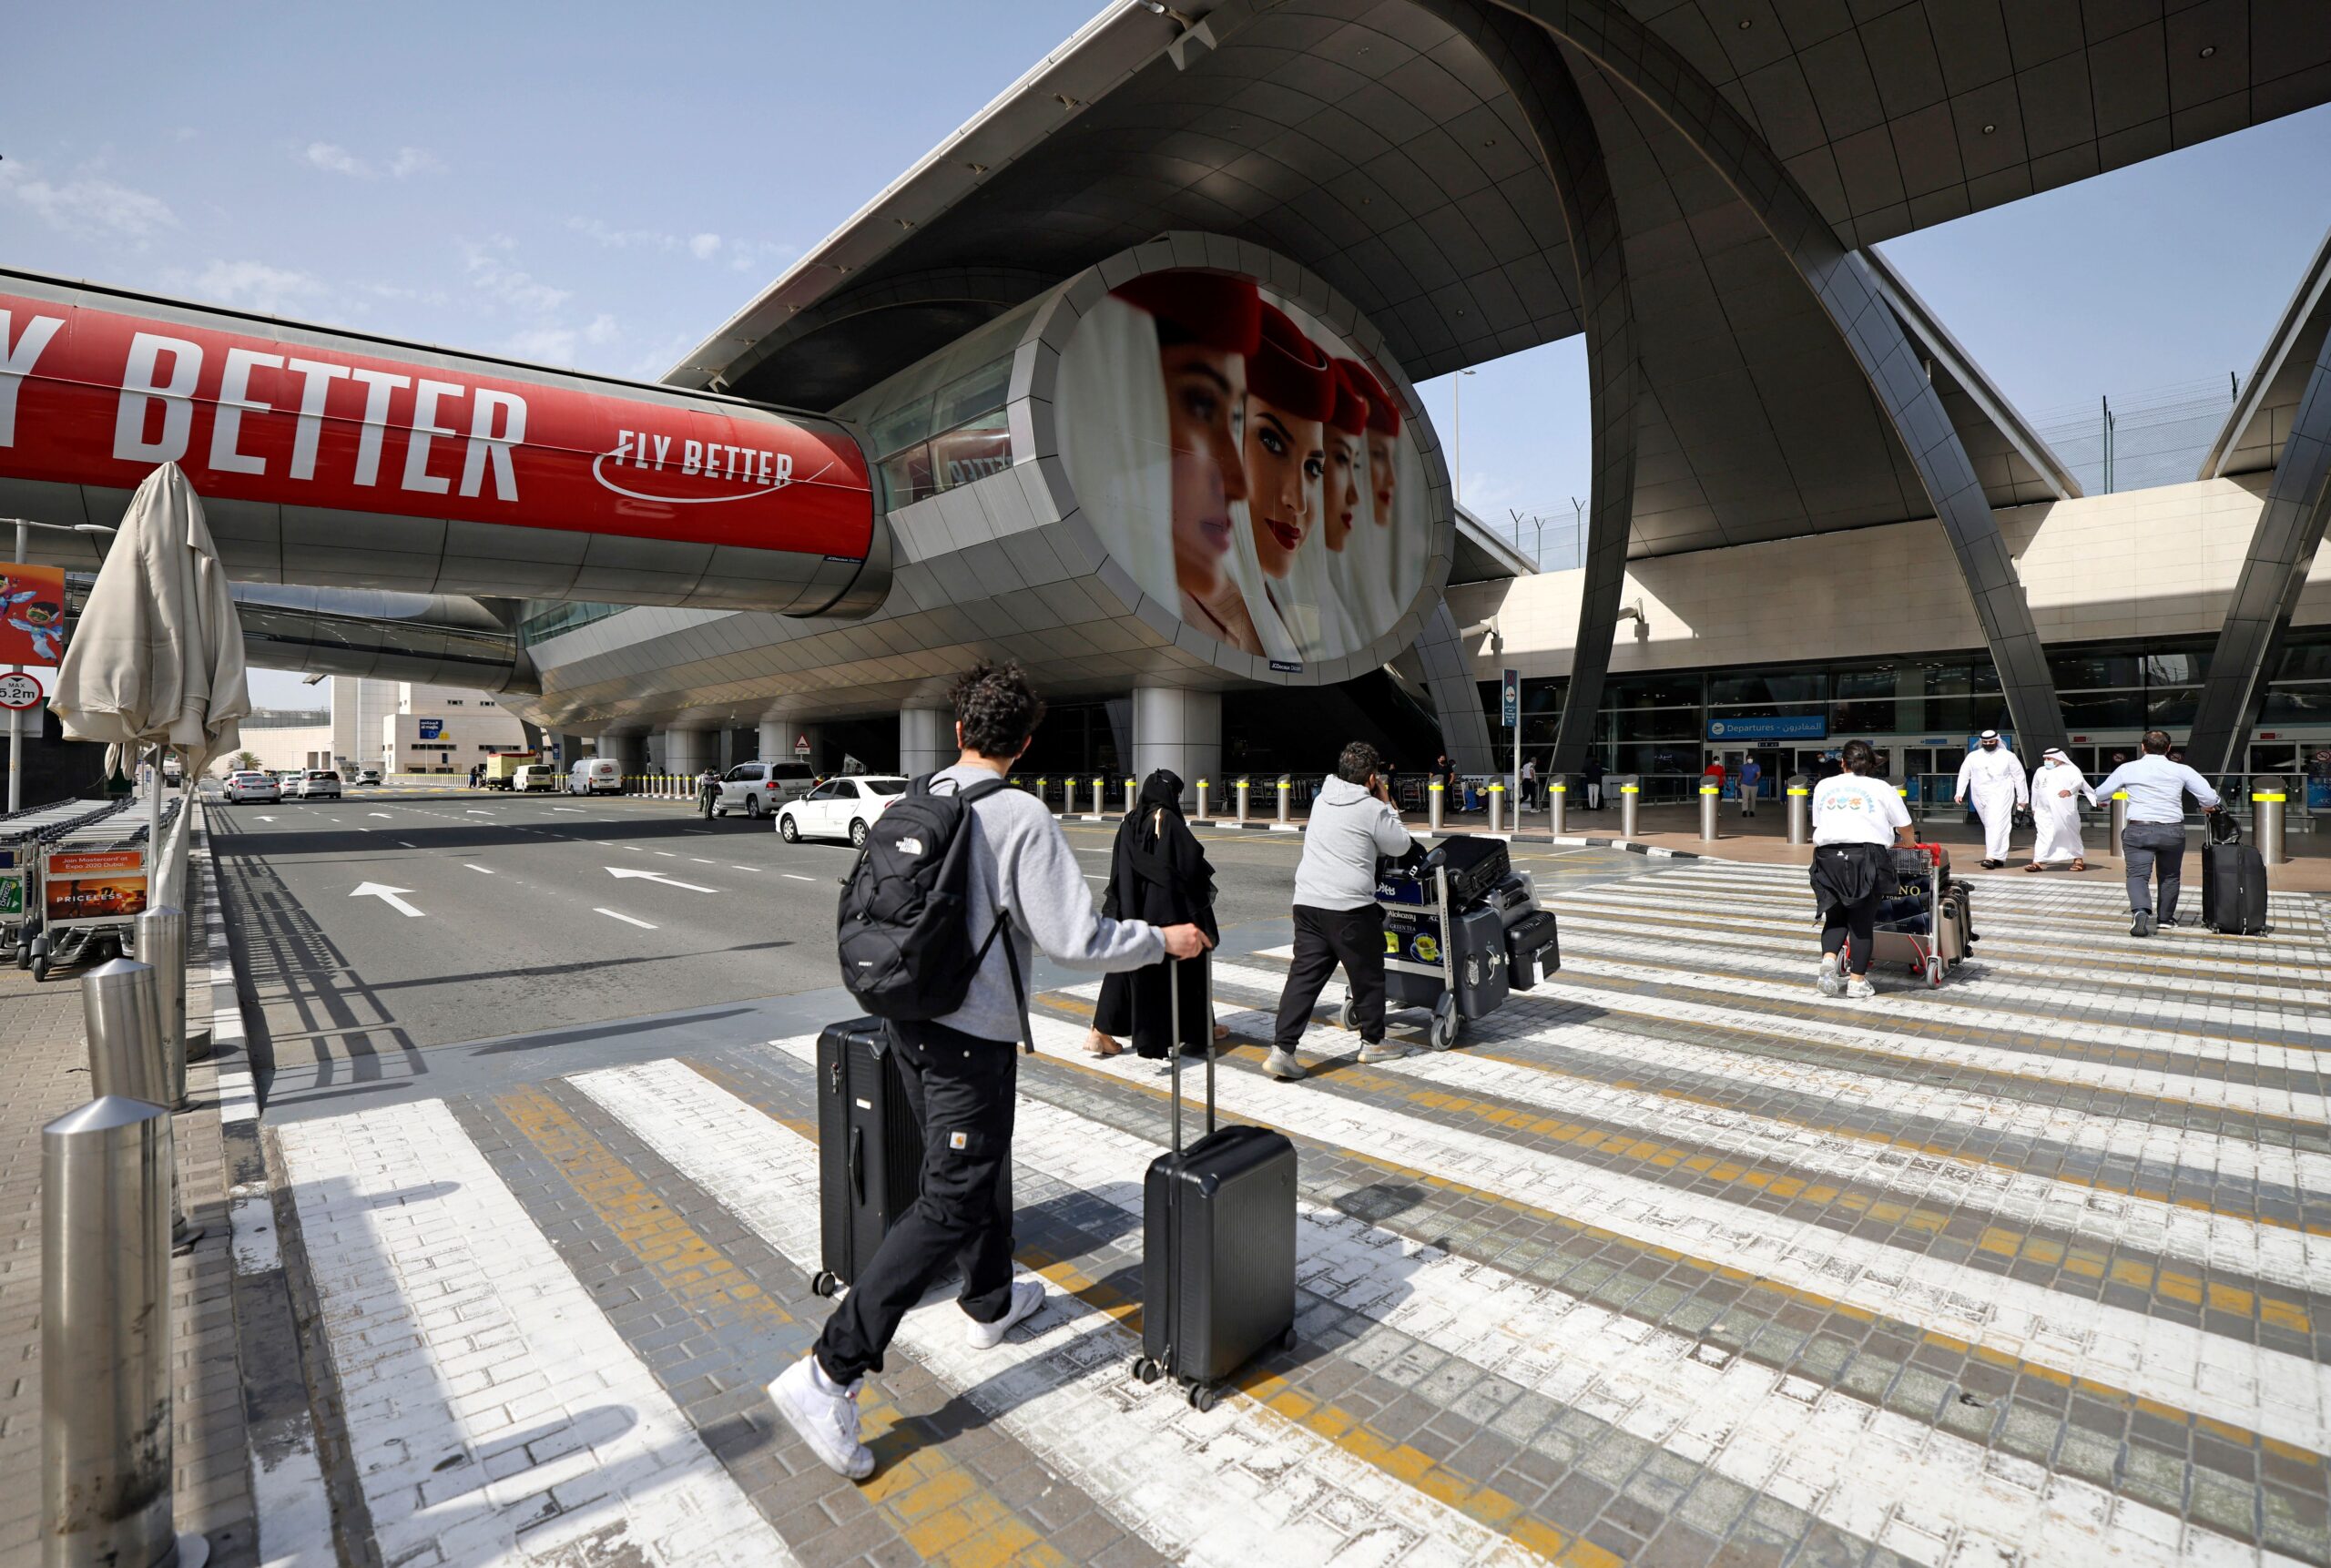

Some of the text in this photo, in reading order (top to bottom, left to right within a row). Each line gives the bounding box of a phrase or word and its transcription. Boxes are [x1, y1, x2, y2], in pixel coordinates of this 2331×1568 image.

[113, 331, 527, 503] BETTER
[615, 429, 793, 486] FLY BETTER
[0, 687, 35, 699] 5.2m
[1782, 722, 1821, 733] المغادرون
[56, 892, 123, 903] PRICELESS
